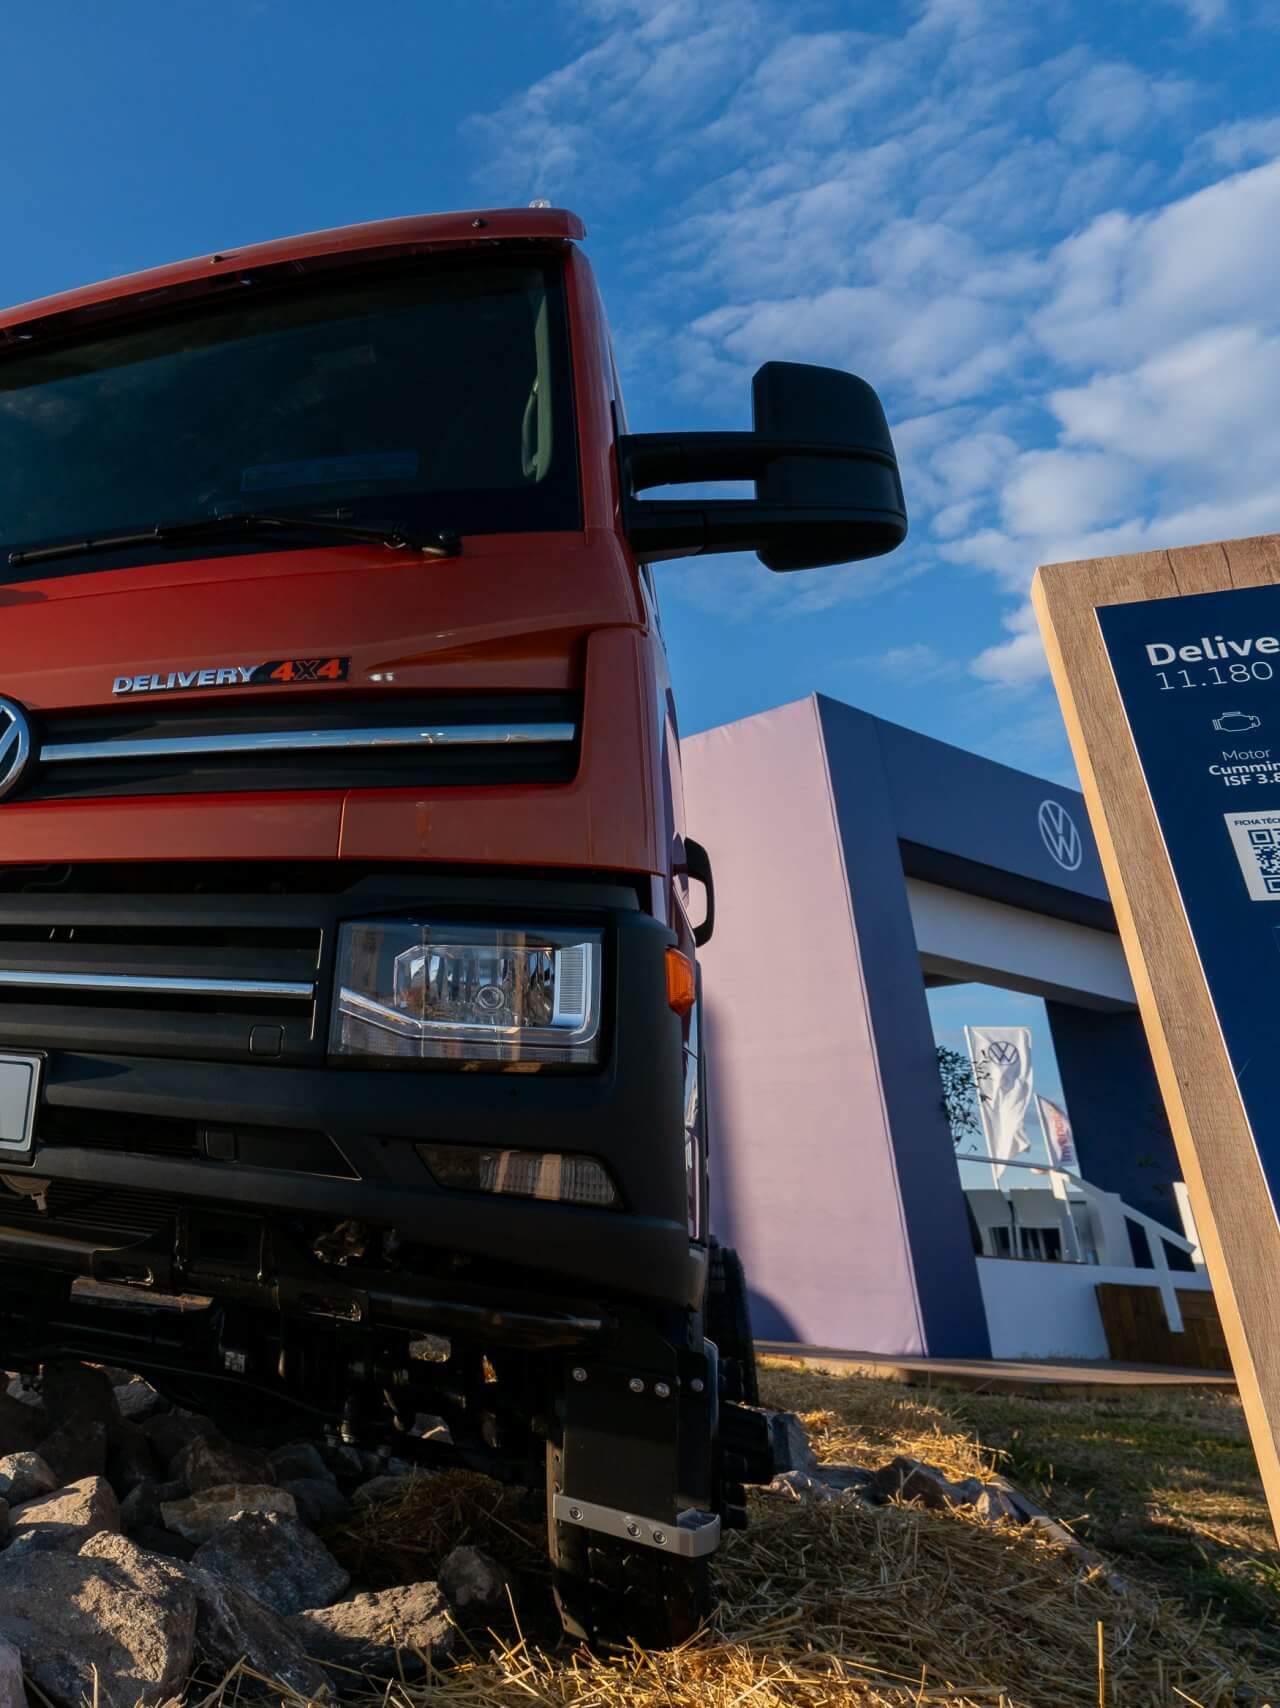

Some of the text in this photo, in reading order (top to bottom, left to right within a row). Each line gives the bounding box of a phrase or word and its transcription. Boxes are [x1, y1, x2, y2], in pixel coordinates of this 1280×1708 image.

[1145, 635, 1280, 666] Delive
[112, 665, 259, 693] DELIVERY
[1155, 661, 1273, 690] 11.180
[1222, 749, 1271, 760] Motor
[1224, 774, 1251, 786] ISF
[1234, 816, 1280, 826] FICHA TÉC
